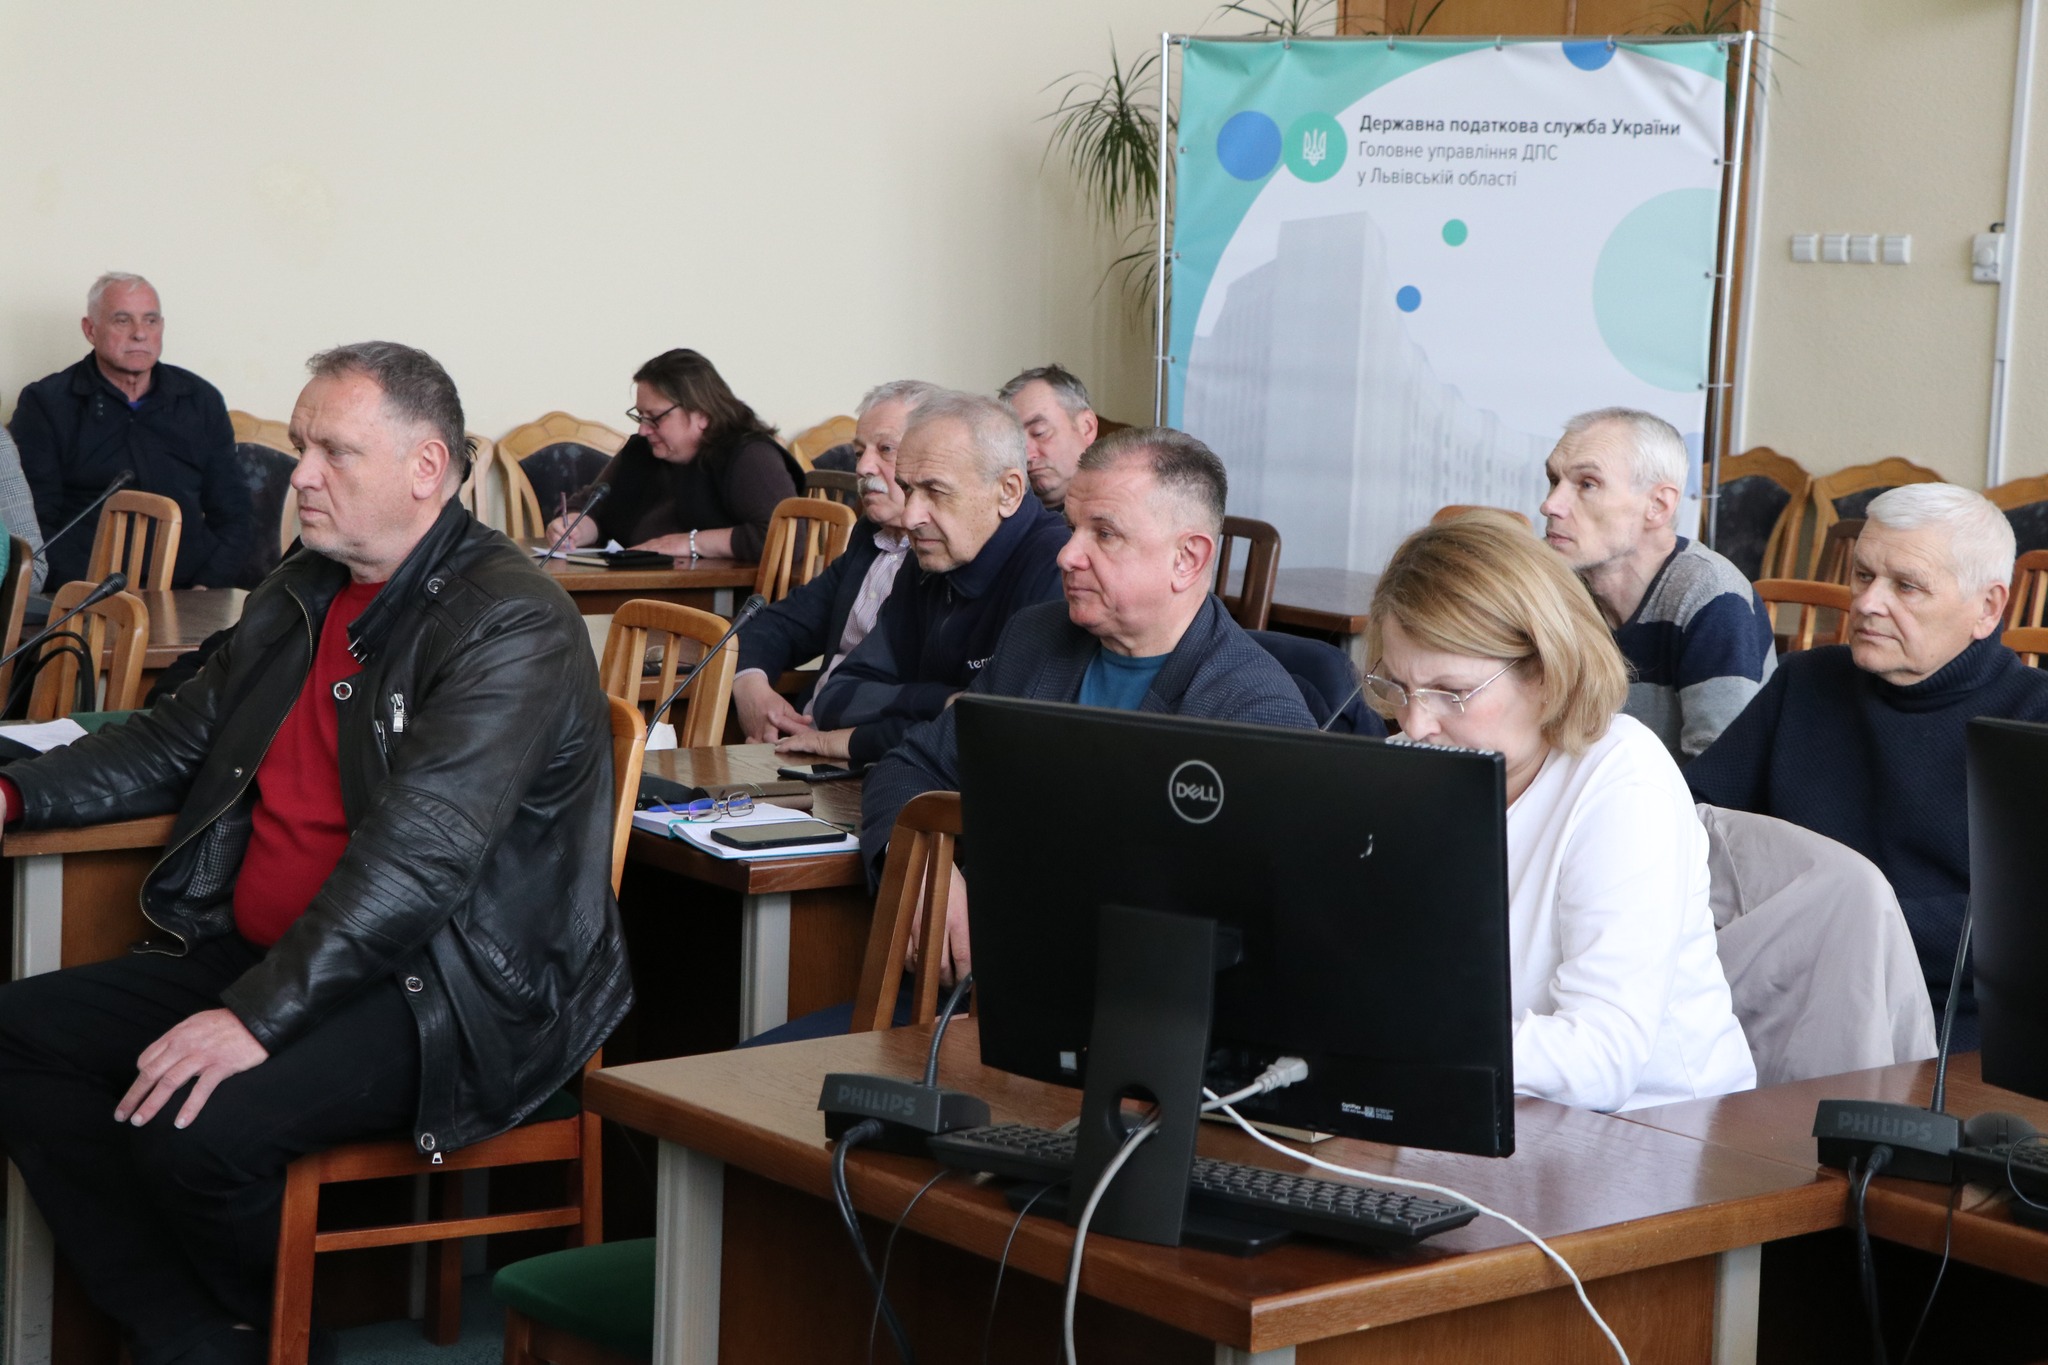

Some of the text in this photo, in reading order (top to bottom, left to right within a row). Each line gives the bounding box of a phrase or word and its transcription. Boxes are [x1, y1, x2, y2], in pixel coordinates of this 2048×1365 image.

[1360, 115, 1681, 137] Державна податкова служба України
[1359, 142, 1558, 162] Головне управління ДПС
[1358, 168, 1516, 186] у Львівській області
[1176, 782, 1218, 802] DELL
[838, 1084, 916, 1116] PHILIPS
[1838, 1112, 1932, 1140] PHILIPS
